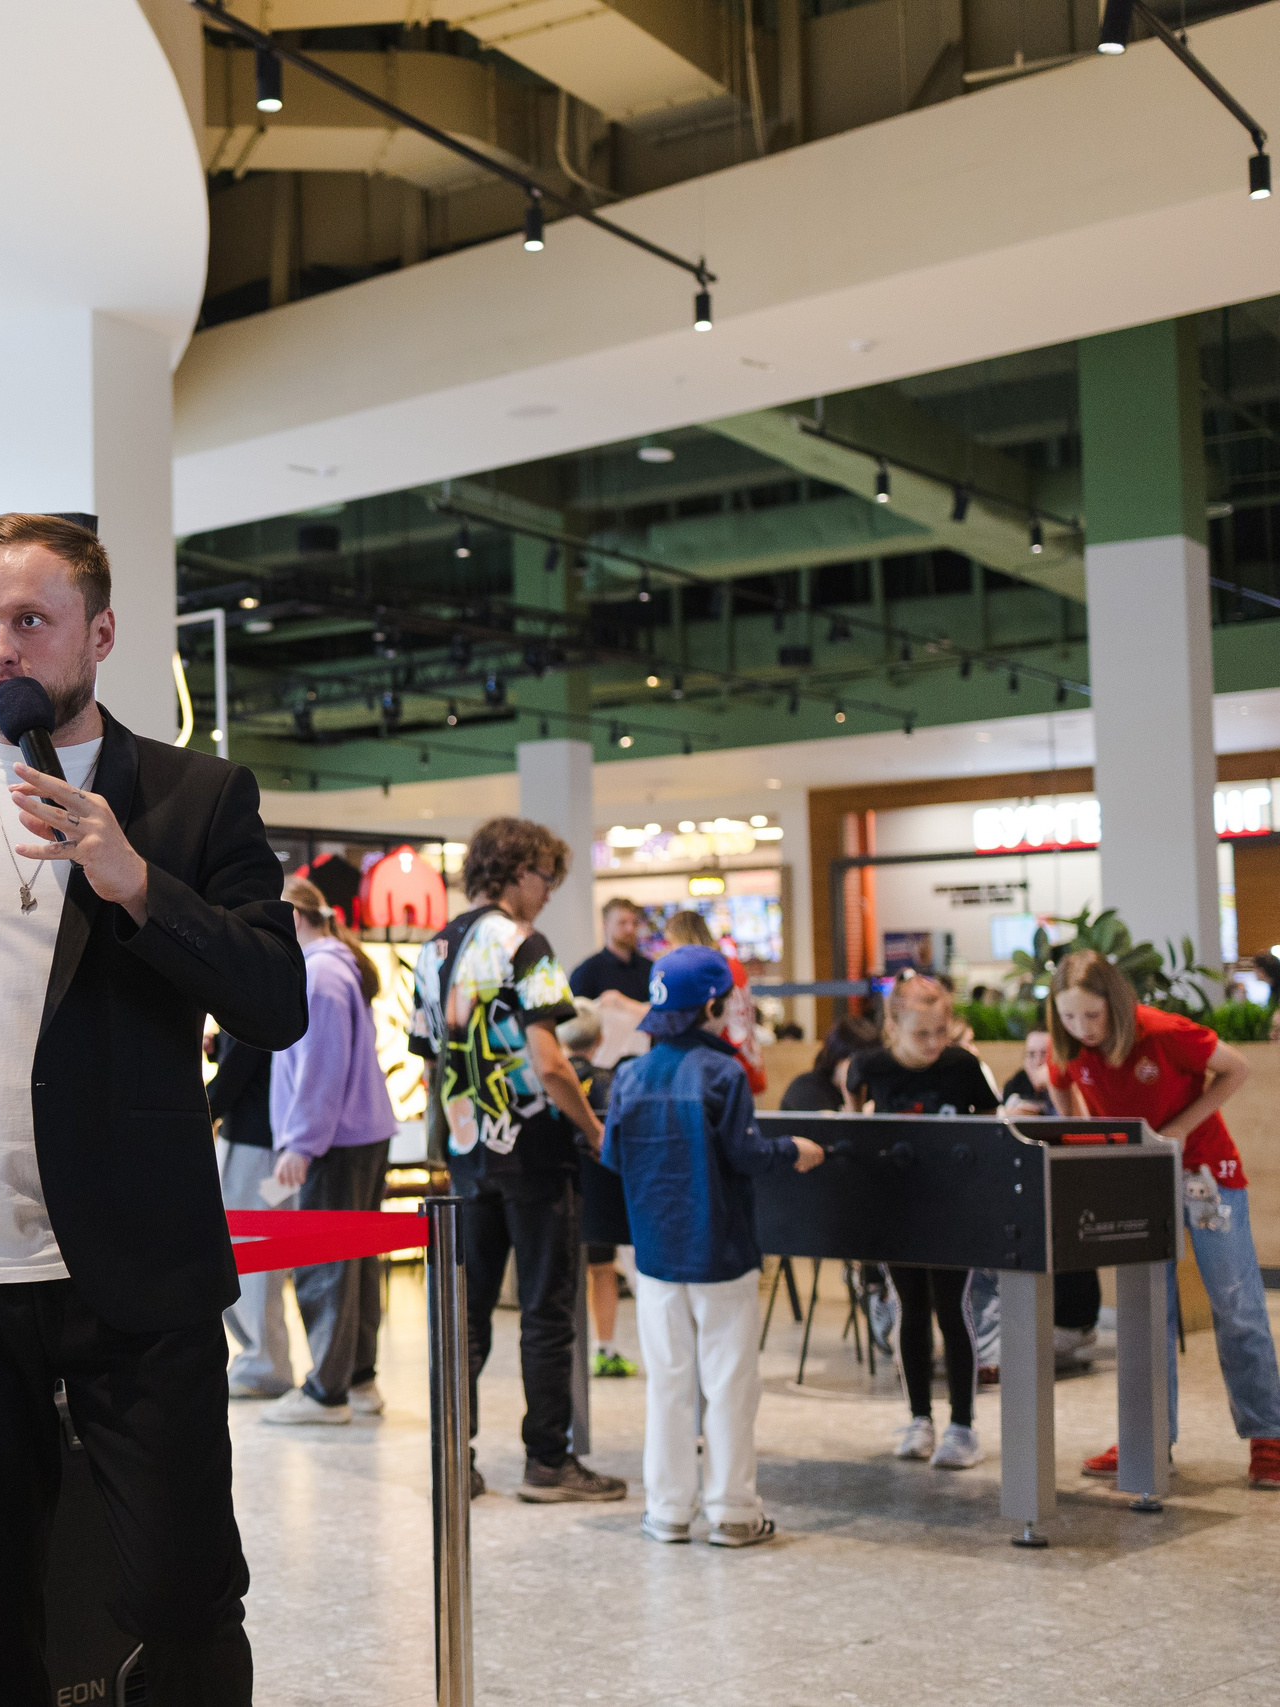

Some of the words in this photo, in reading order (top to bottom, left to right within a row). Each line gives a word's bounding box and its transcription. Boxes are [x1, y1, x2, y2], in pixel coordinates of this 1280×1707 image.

[973, 800, 1101, 850] БУРГЕ
[1214, 788, 1271, 834] НГ
[57, 1677, 106, 1707] EON
